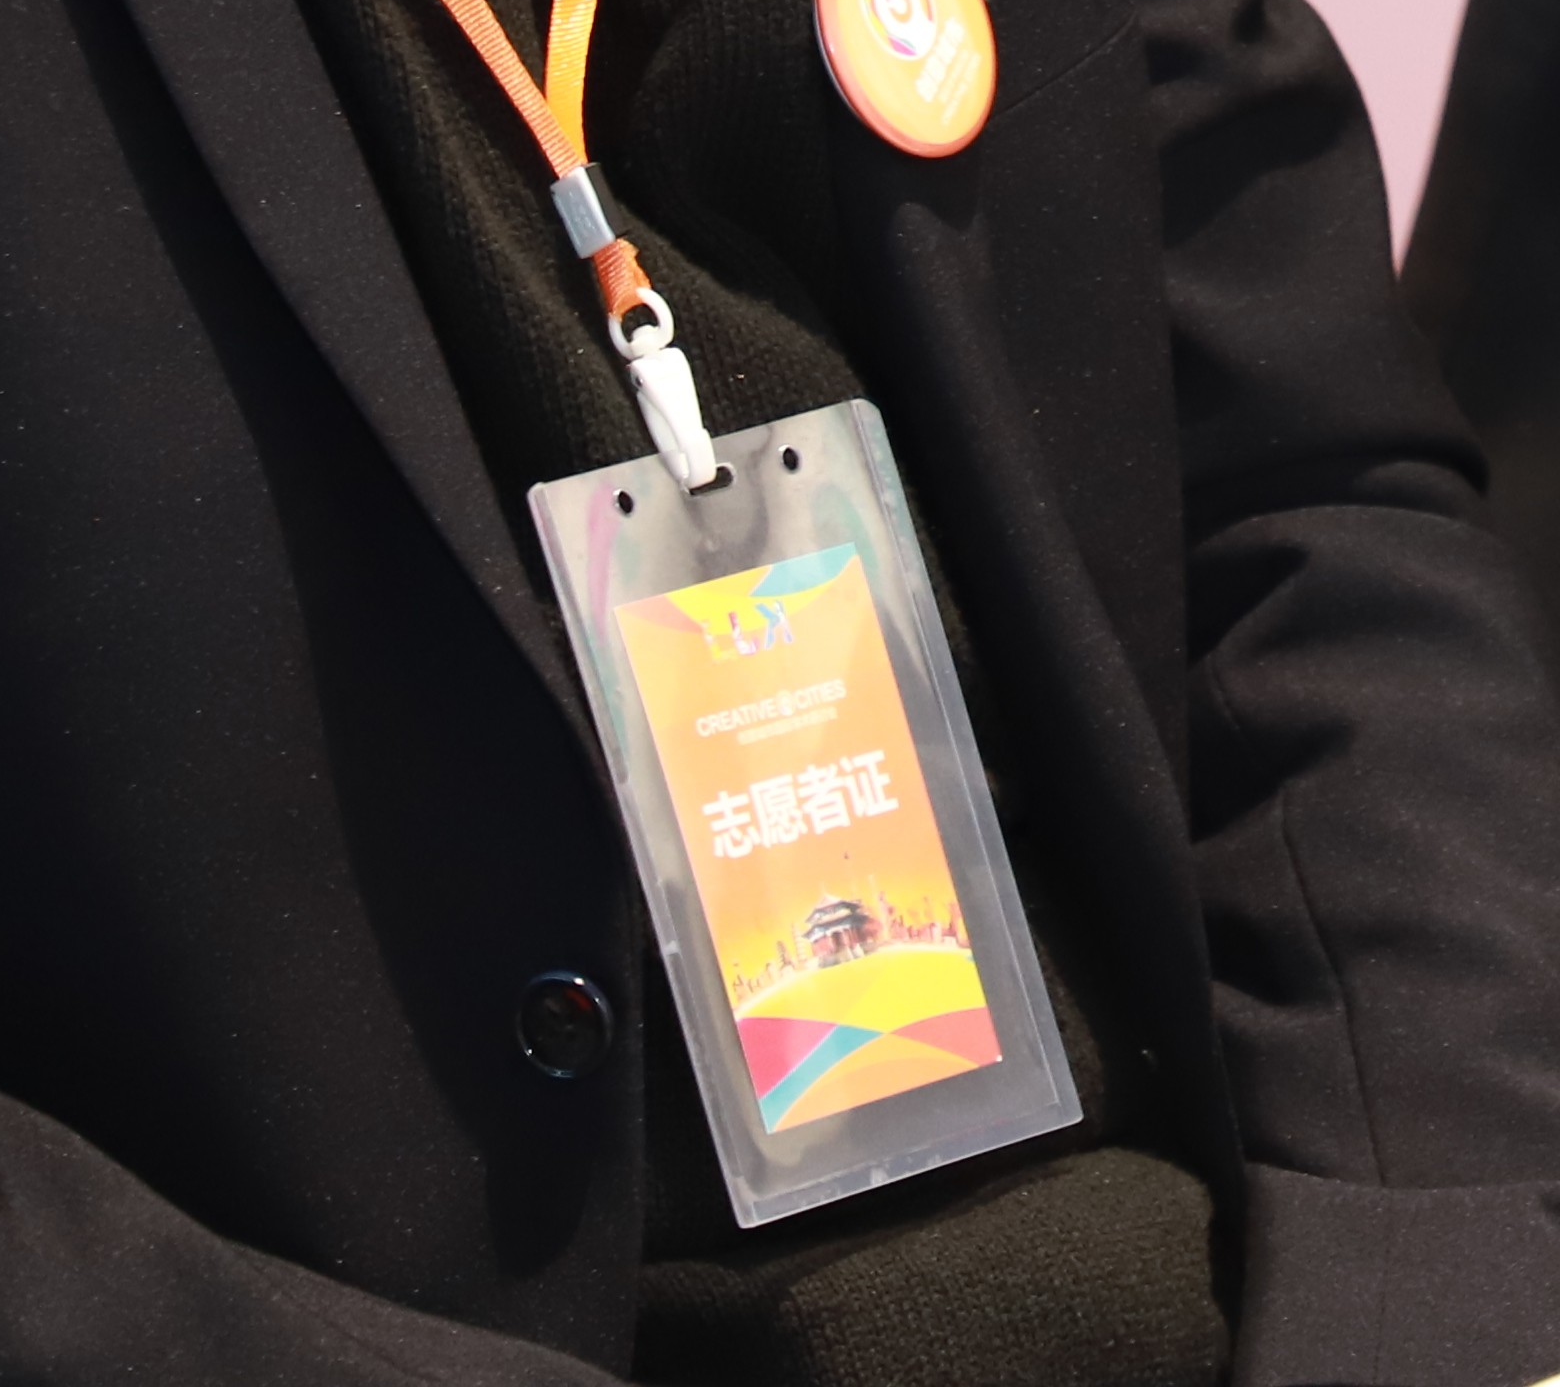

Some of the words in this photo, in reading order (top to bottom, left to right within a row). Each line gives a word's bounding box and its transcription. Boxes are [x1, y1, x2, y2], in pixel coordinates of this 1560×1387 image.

[695, 698, 778, 738] CREATIVE
[794, 678, 848, 710] CITIES
[701, 748, 900, 859] 志愿者证
